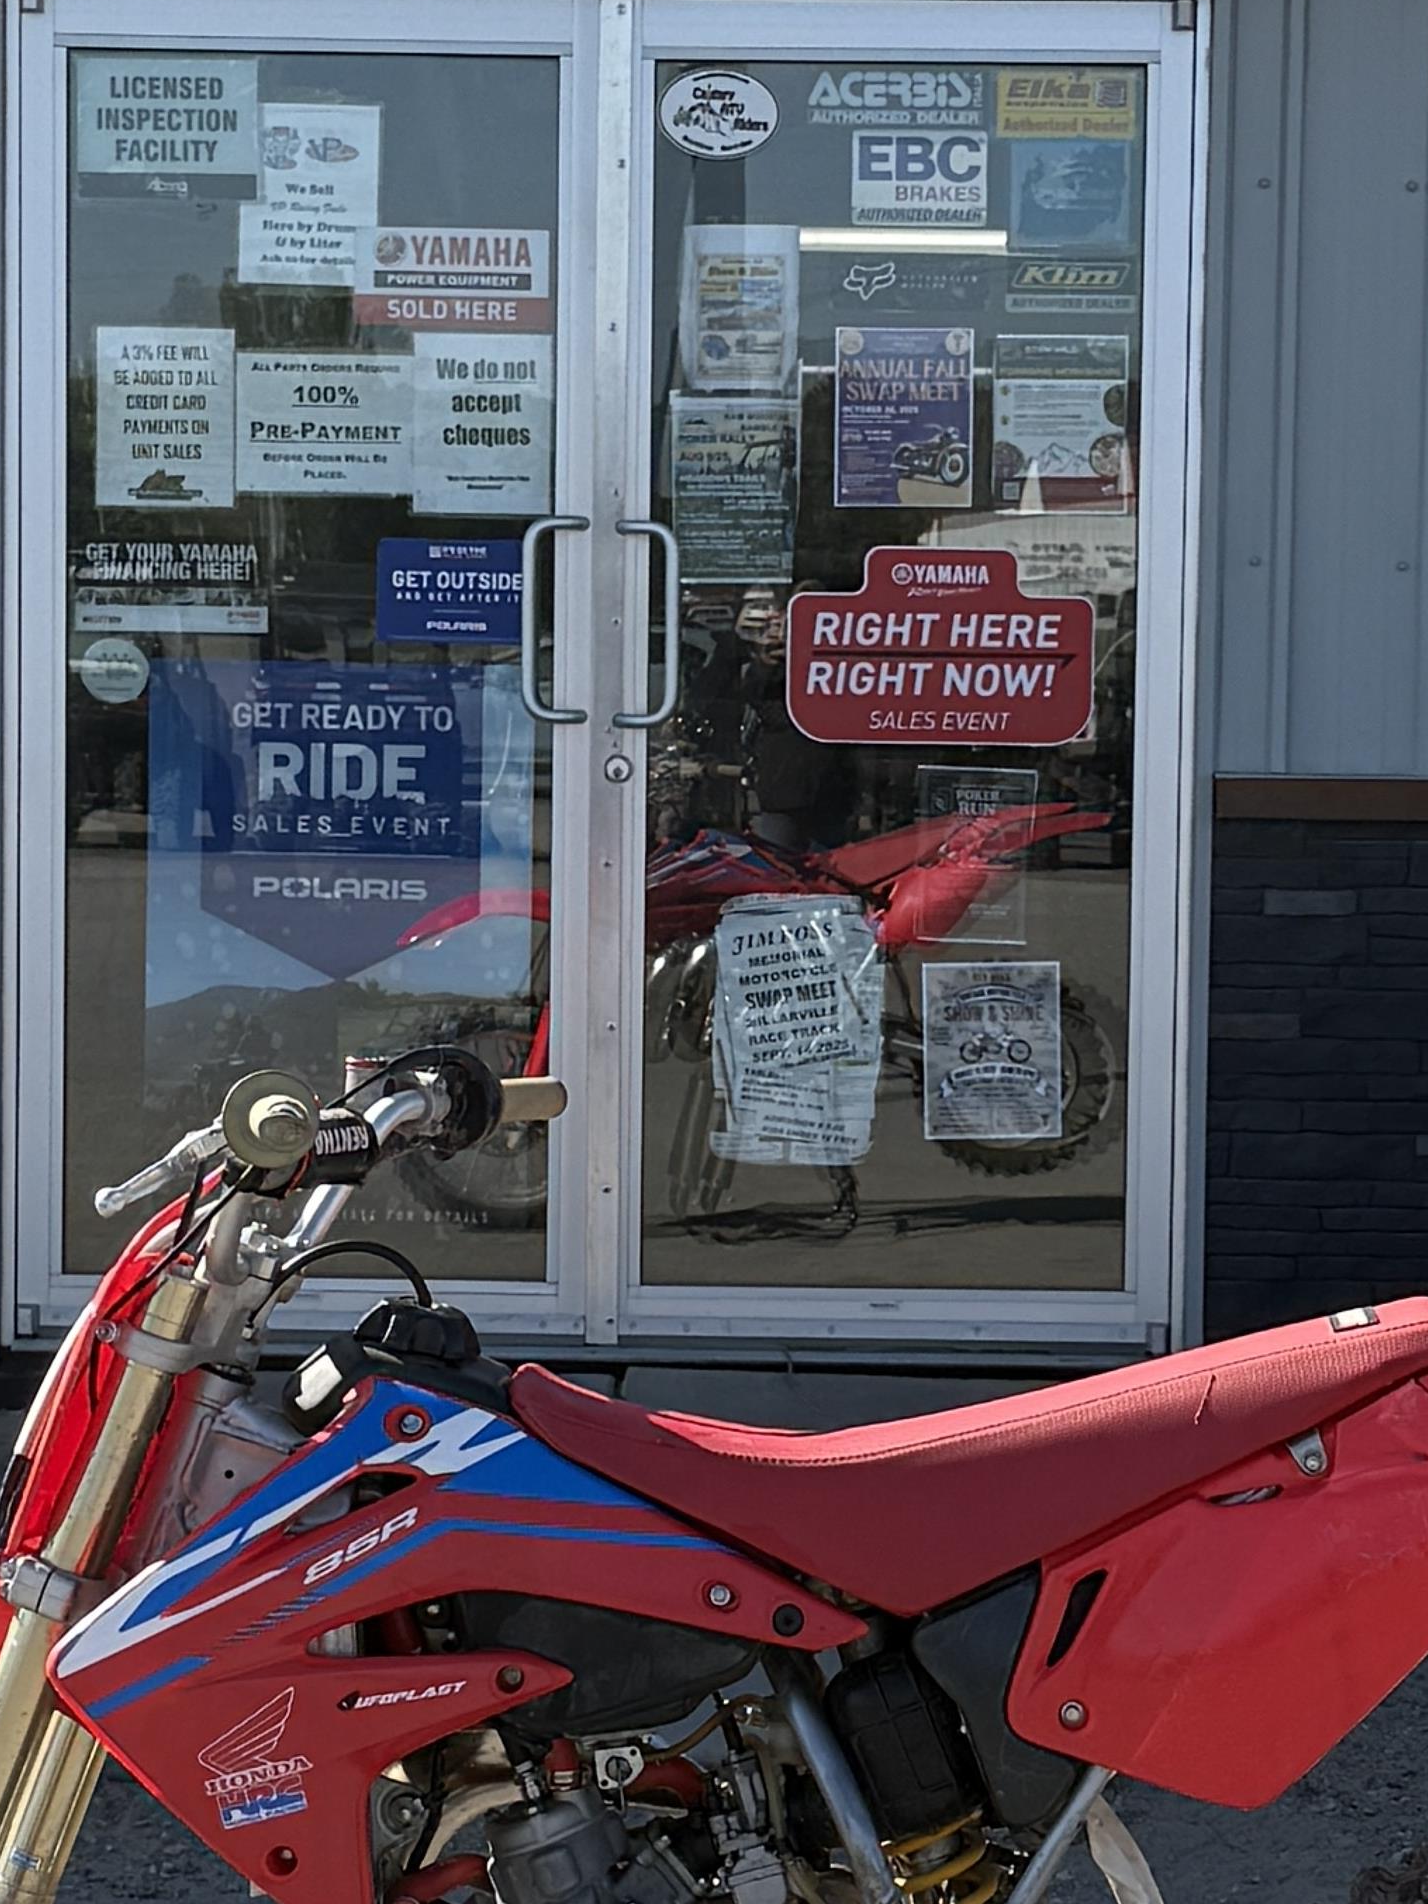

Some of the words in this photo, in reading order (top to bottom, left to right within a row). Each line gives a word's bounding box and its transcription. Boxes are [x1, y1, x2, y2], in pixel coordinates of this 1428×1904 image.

[110, 77, 223, 100] LICENSED
[97, 108, 237, 132] INSPECTION
[810, 110, 910, 124] AUTHORIZED
[915, 110, 979, 125] DEALER
[1083, 117, 1130, 133] Dealer
[115, 139, 218, 162] FACILITY
[858, 136, 981, 182] EBC
[285, 183, 306, 195] We
[309, 183, 334, 195] Sell
[895, 186, 981, 202] BRAKES
[857, 208, 933, 222] AUTHORIZED
[934, 208, 983, 222] DEALER
[297, 220, 313, 234] by
[289, 236, 305, 250] by
[411, 235, 532, 267] YAMAHA
[387, 275, 436, 286] POWER
[439, 275, 518, 287] EQUIPMENT
[387, 299, 448, 320] SOLD
[455, 300, 517, 321] HERE
[157, 346, 178, 361] FEE
[182, 346, 210, 361] WILL
[114, 370, 129, 386] BE
[133, 370, 173, 386] ADDED
[178, 370, 193, 386] TO
[196, 371, 219, 386] ALL
[436, 357, 469, 380] We
[473, 357, 498, 380] do
[503, 358, 537, 381] not
[840, 359, 920, 378] ANNUAL
[923, 359, 970, 379] FALL
[293, 385, 359, 405] 100%
[846, 381, 905, 401] SWAP
[908, 381, 964, 402] MEET
[126, 395, 168, 410] CREDIT
[173, 395, 206, 410] CARD
[452, 393, 522, 415] accept
[124, 420, 188, 435] PAYMENTS
[191, 420, 210, 435] ON
[250, 421, 402, 441] PRE-PAYMENT
[443, 424, 531, 448] cheques
[132, 444, 159, 459] UNIT
[163, 444, 202, 460] SALES
[86, 543, 119, 561] GET
[126, 543, 173, 561] YOUR
[179, 544, 259, 563] YAMAHA
[93, 562, 191, 581] FINANCING
[197, 562, 251, 581] HERE!
[392, 570, 432, 588] GET
[436, 571, 523, 591] OUTSIDE
[914, 565, 990, 585] YAMAHA
[813, 612, 940, 646] RIGHT
[950, 614, 1062, 648] HERE
[806, 661, 933, 695] RIGHT
[943, 663, 1056, 697] NOW!
[232, 702, 293, 728] GET
[301, 703, 407, 731] READY
[414, 705, 454, 732] TO
[869, 710, 935, 730] SALES
[942, 711, 1011, 731] EVENT
[258, 742, 426, 804] RIDE
[957, 802, 997, 816] RUN
[232, 814, 332, 834] SALES
[350, 815, 451, 837] EVENT
[253, 877, 428, 900] POLARIS
[732, 930, 773, 956] JIM
[748, 947, 826, 968] MEMORIAL
[739, 963, 837, 986] MOTORCYCLE
[745, 986, 793, 1010] SWAP
[796, 980, 837, 1002] MEET
[748, 1029, 787, 1046] RACE
[792, 1022, 841, 1040] TRACK
[315, 1126, 369, 1156] RENTHA
[424, 1209, 489, 1224] DETAILS
[354, 1681, 467, 1709] UFOPLAST
[204, 1756, 313, 1796] HONDA
